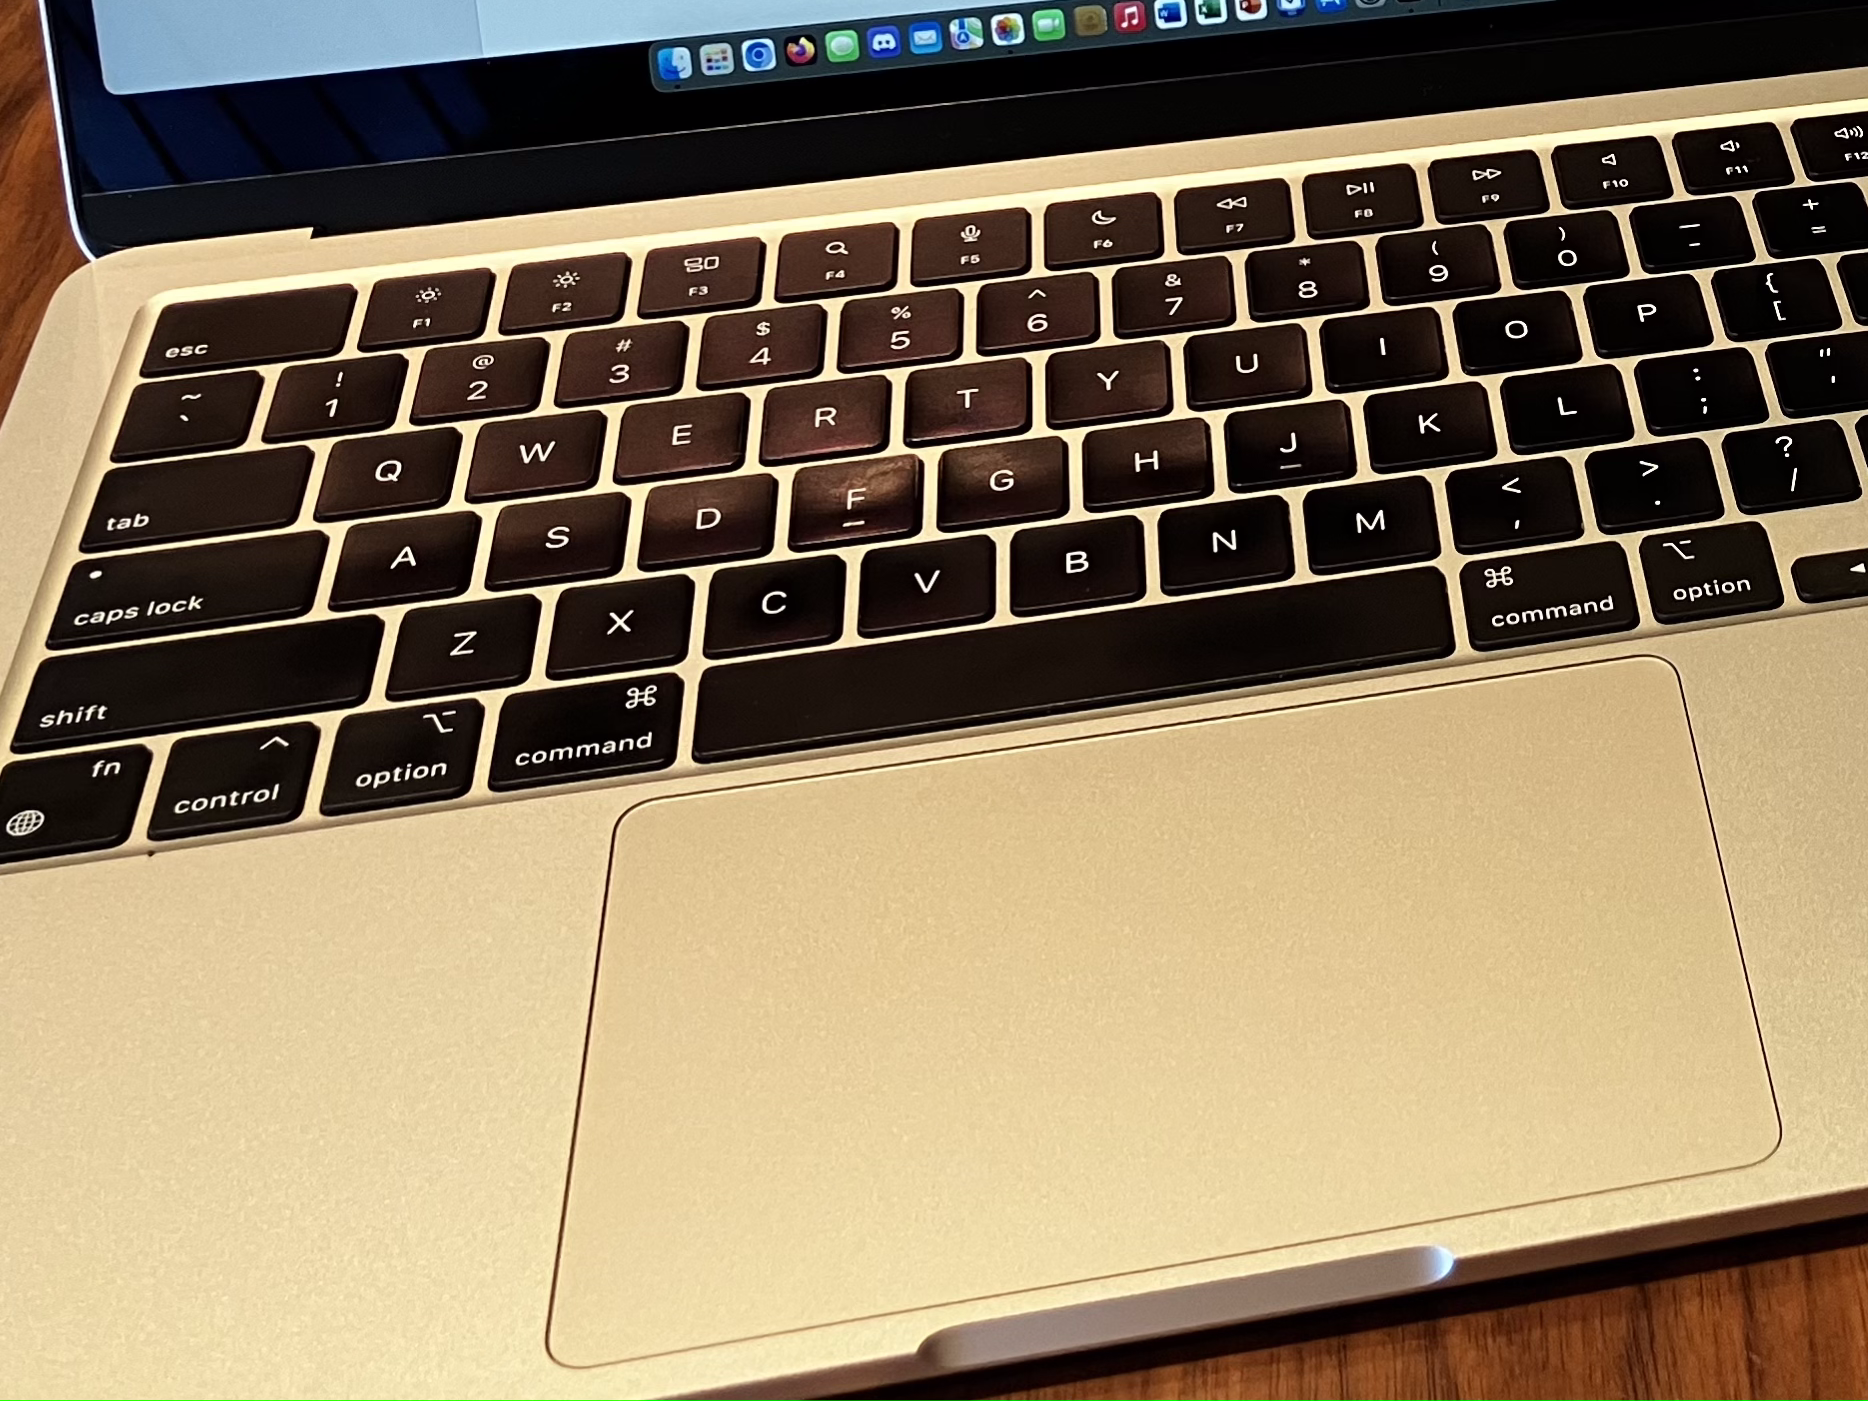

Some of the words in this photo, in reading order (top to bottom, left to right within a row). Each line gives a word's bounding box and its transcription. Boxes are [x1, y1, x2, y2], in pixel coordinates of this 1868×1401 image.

[165, 342, 209, 359] esc
[325, 398, 340, 418] 1
[467, 381, 489, 401] 2
[609, 364, 630, 384] 3
[749, 347, 771, 365] 4
[890, 331, 911, 349] 5
[1027, 314, 1048, 332] 6
[1164, 297, 1184, 316] 7
[1298, 281, 1319, 299] 8
[1429, 264, 1450, 282] 9
[412, 318, 432, 329] F1
[551, 302, 572, 313] F2
[688, 286, 709, 296] F3
[825, 270, 846, 280] F4
[960, 254, 980, 265] F5
[1093, 239, 1113, 250] F6
[1225, 223, 1244, 234] F7
[1354, 208, 1374, 219] F8
[1481, 193, 1500, 203] F9
[1602, 178, 1629, 190] F10
[1725, 163, 1749, 175] F11
[73, 605, 139, 628] caps
[147, 595, 204, 617] lock
[390, 547, 417, 570] A
[545, 527, 570, 548] S
[696, 509, 722, 530] D
[846, 489, 867, 510] F
[989, 470, 1015, 491] G
[1134, 451, 1161, 473] H
[1280, 432, 1297, 454] J
[1419, 414, 1442, 435] K
[1558, 397, 1577, 416] L
[106, 512, 150, 532] tab
[374, 460, 402, 482] Q
[519, 441, 556, 464] W
[671, 424, 693, 446] E
[814, 407, 838, 428] R
[956, 388, 979, 409] T
[1096, 371, 1119, 392] Y
[1235, 353, 1259, 374] U
[1504, 320, 1529, 340] O
[1636, 303, 1658, 323] P
[39, 704, 107, 729] shift
[450, 632, 478, 656] Z
[607, 610, 634, 635] X
[761, 591, 788, 614] C
[914, 570, 941, 593] V
[1065, 551, 1089, 573] B
[1213, 530, 1237, 552] N
[1356, 512, 1386, 534] M
[91, 759, 121, 778] fn
[173, 784, 280, 815] control
[355, 760, 448, 789] option
[514, 733, 653, 768] command
[1491, 595, 1615, 629] command
[1672, 574, 1752, 605] option
